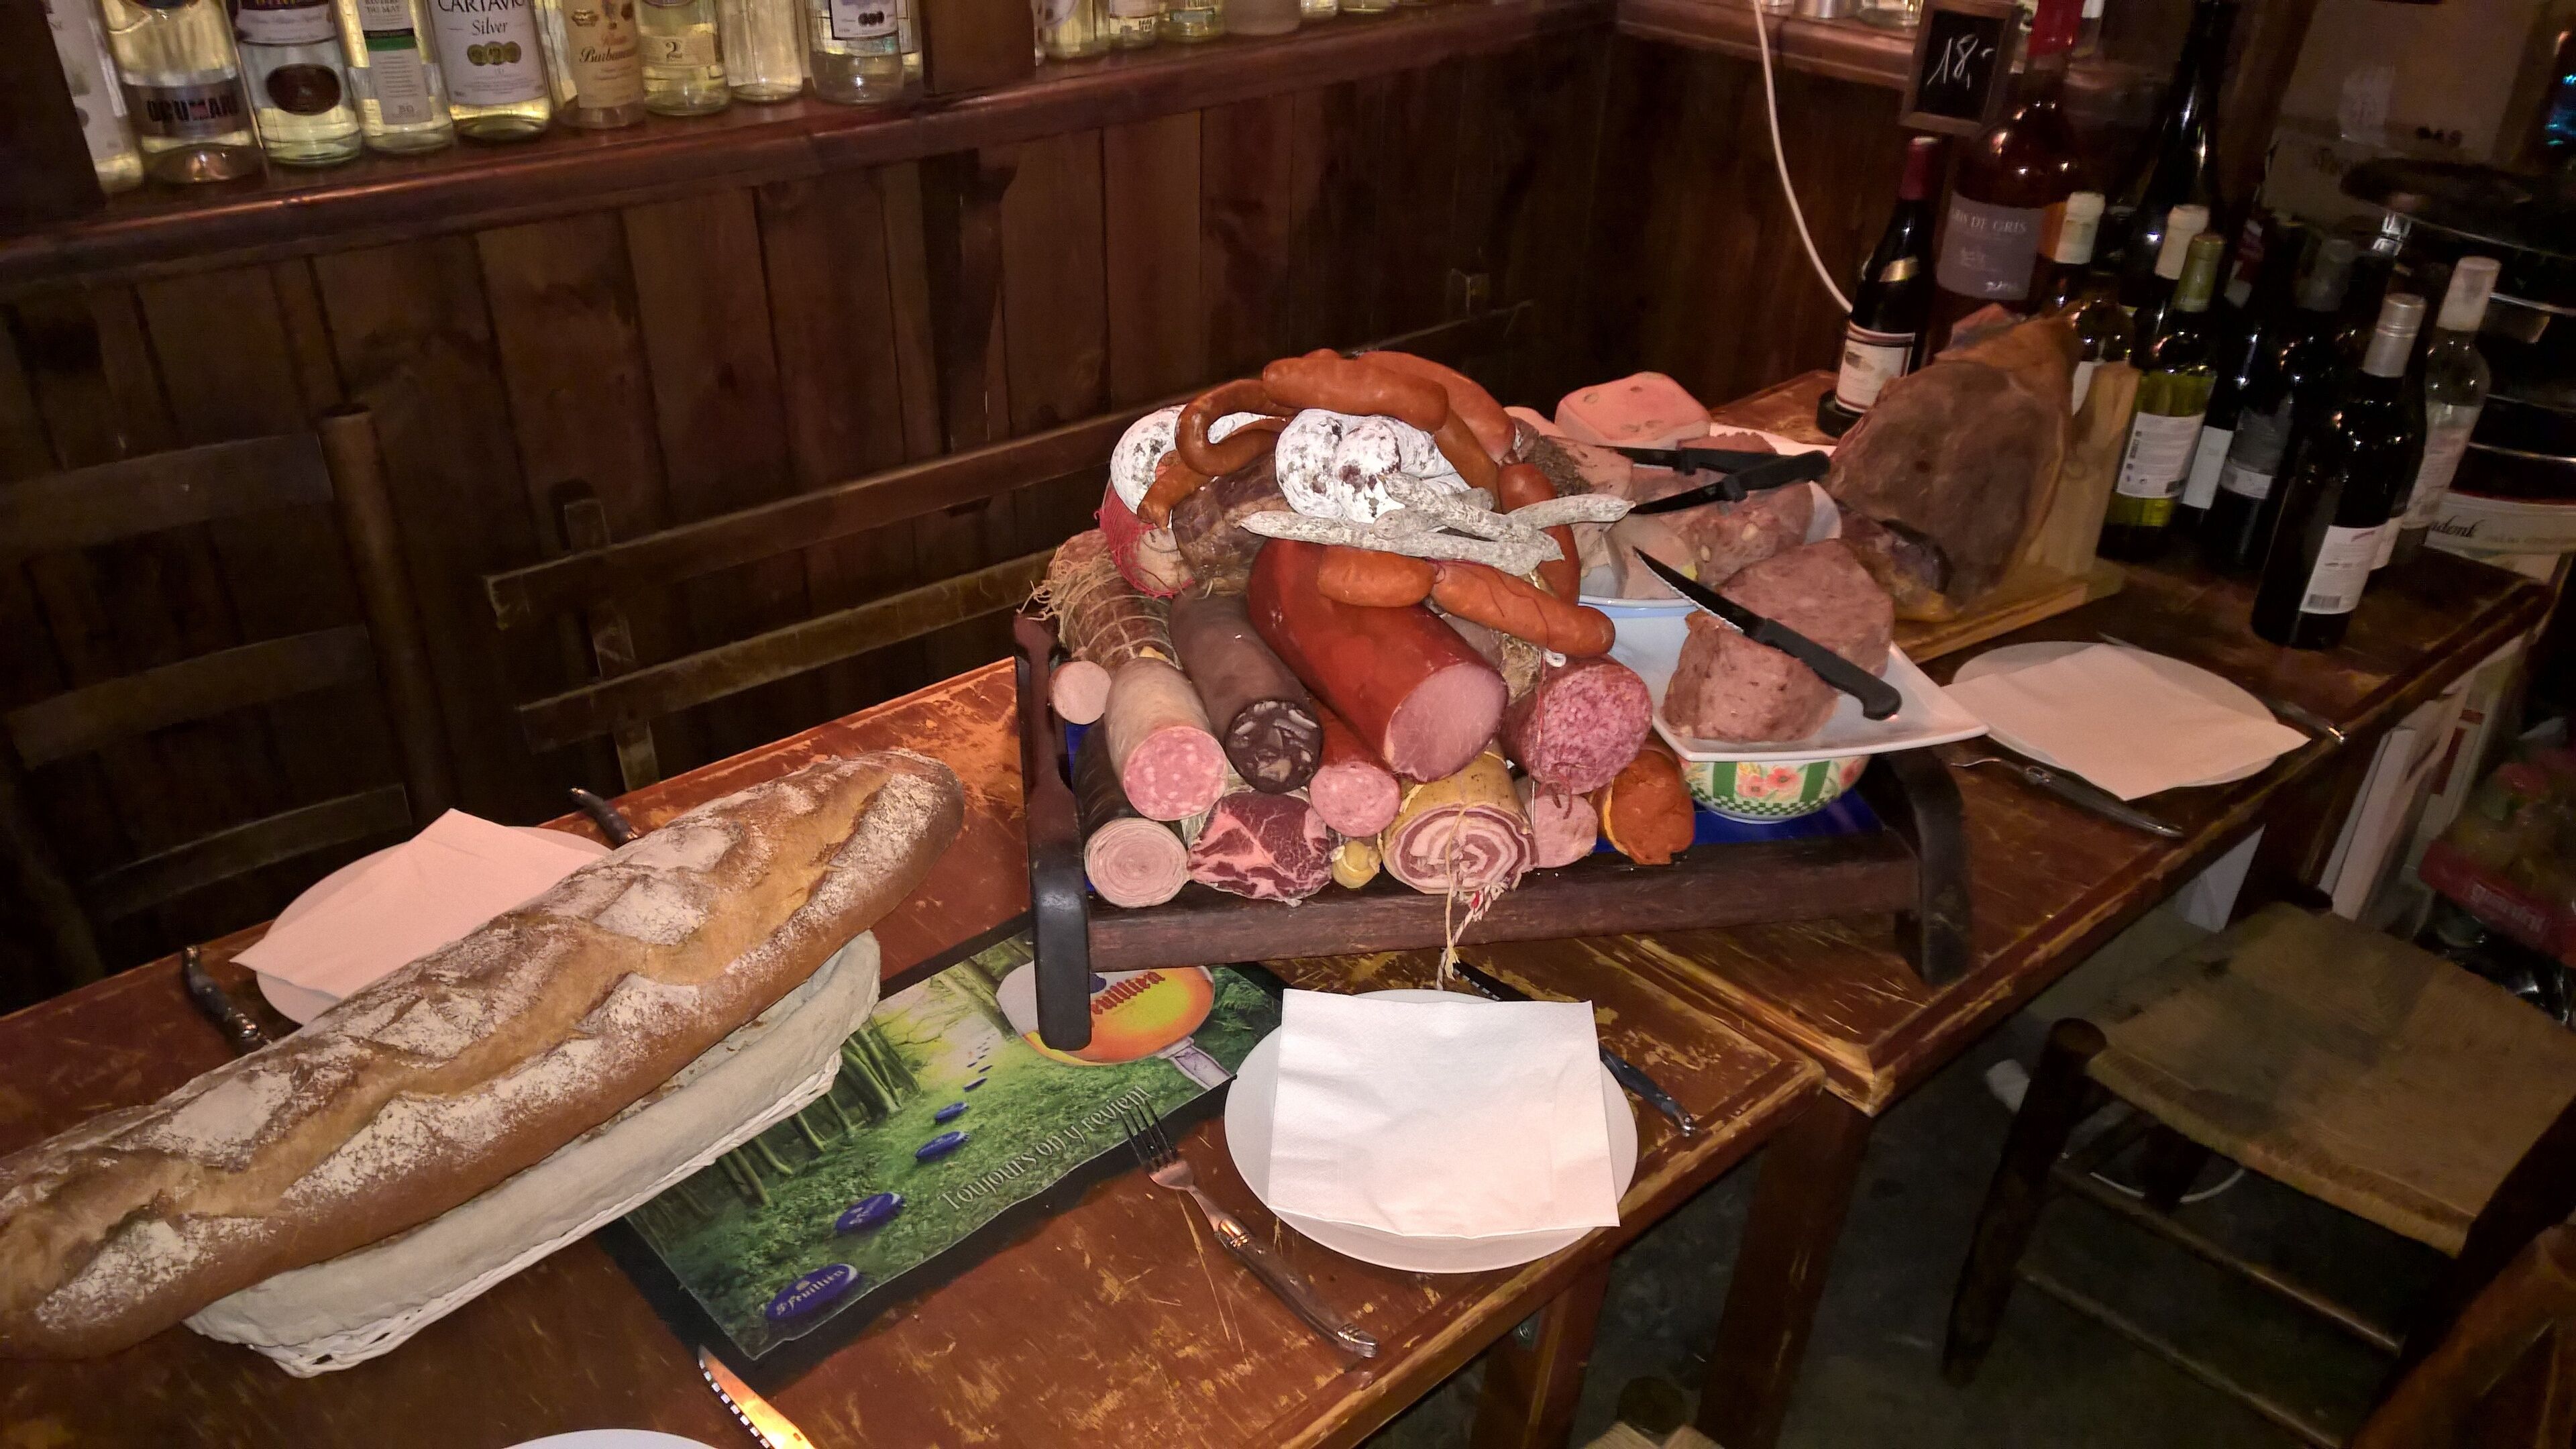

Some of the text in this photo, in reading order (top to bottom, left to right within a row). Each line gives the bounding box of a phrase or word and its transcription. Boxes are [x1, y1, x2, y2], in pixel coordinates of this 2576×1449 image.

[472, 17, 508, 35] Silver
[1090, 971, 1166, 1015] euillien
[937, 1085, 1155, 1210] Toujours on y revient
